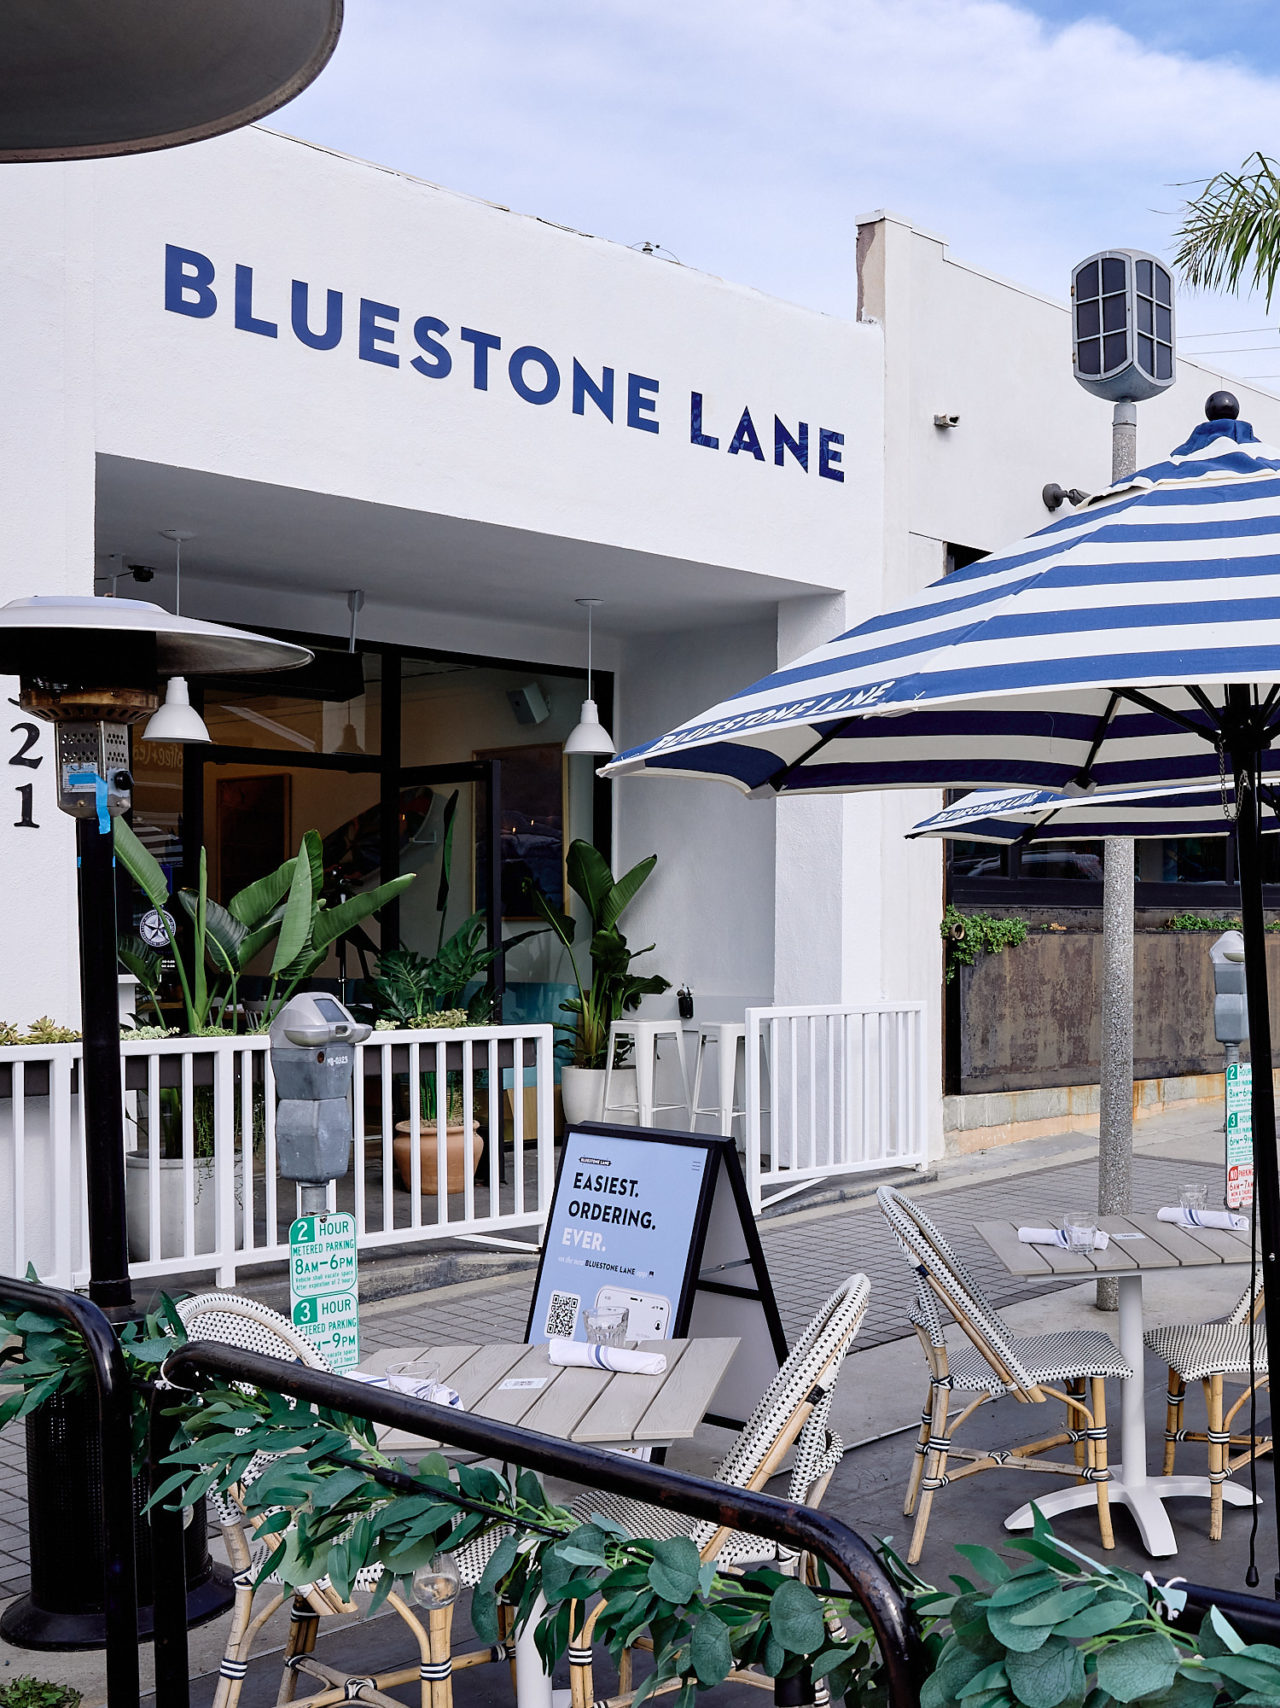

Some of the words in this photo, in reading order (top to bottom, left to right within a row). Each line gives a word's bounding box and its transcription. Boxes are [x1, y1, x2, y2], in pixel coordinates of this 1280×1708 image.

[165, 244, 659, 434] BLUESTONE
[691, 391, 844, 483] LANE
[646, 704, 808, 754] BLUESTONE
[806, 681, 895, 716] LANE
[1230, 1067, 1235, 1079] 2
[1231, 1114, 1236, 1127] 3
[573, 1172, 639, 1198] EASIEST.
[568, 1200, 656, 1230] ORDERING.
[297, 1221, 308, 1241] 2
[320, 1221, 349, 1236] HOUR
[562, 1228, 606, 1251] EVER.
[293, 1244, 323, 1257] METERED
[326, 1239, 354, 1252] PARKING
[585, 1260, 619, 1272] BLUESTONE
[619, 1266, 636, 1275] LANE
[300, 1302, 311, 1322] 3
[322, 1299, 351, 1315] HOUR
[329, 1318, 357, 1331] PARKING
